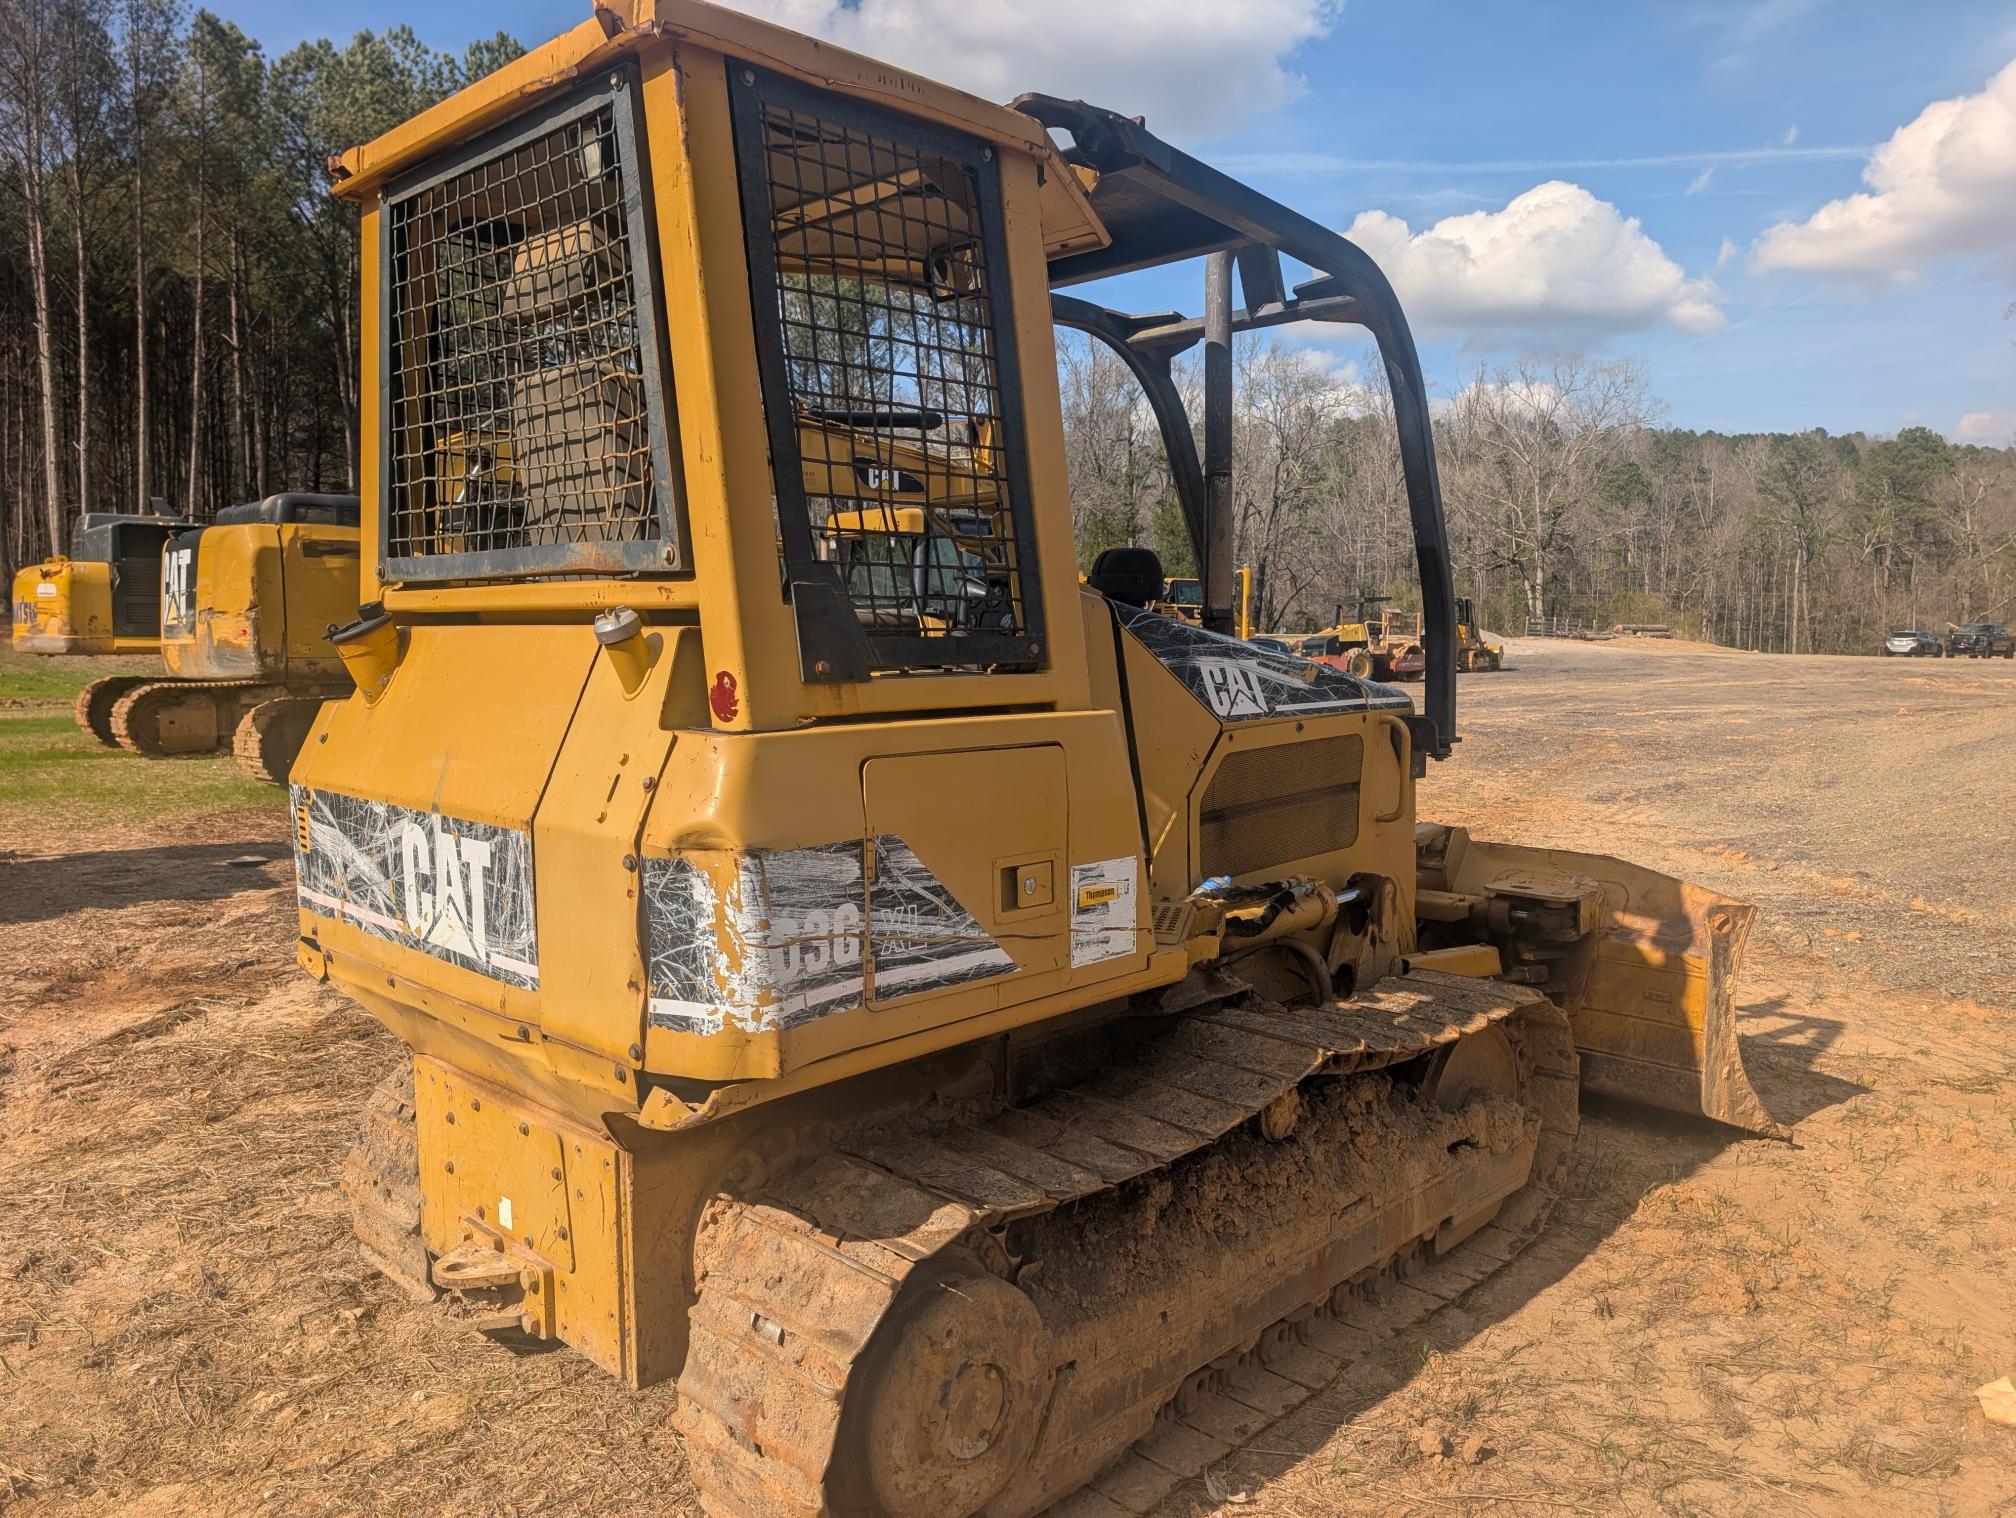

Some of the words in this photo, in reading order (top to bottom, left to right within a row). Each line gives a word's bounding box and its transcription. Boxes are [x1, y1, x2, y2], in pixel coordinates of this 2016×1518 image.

[1200, 660, 1269, 716] CAT
[401, 820, 491, 963] CAT
[1085, 886, 1115, 901] Thompson
